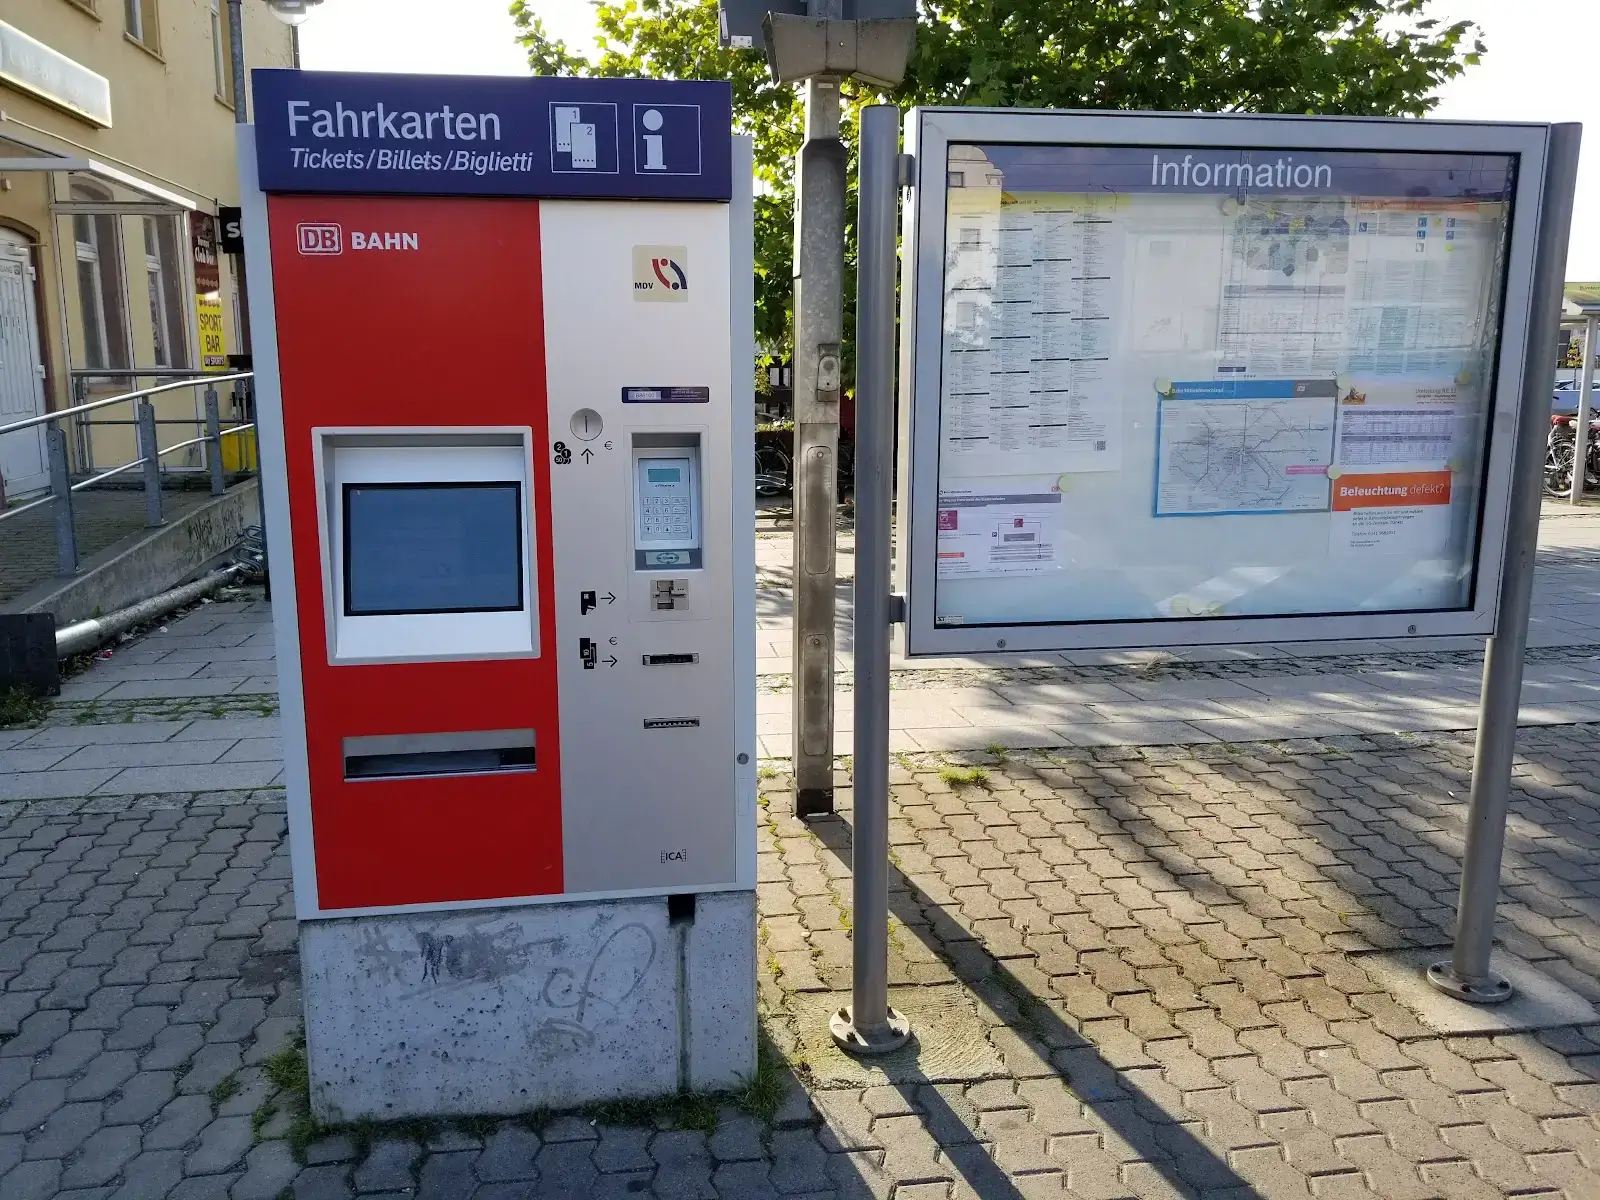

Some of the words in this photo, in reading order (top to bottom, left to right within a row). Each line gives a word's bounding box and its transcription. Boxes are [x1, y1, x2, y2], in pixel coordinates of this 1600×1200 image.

[288, 100, 501, 141] Fahrkarten
[1151, 154, 1332, 188] Information
[302, 228, 336, 249] DB
[351, 231, 419, 250] BAHN
[634, 282, 654, 290] MDV
[200, 313, 222, 332] SPORT
[205, 335, 221, 353] BAR
[1340, 485, 1408, 497] Beleuchtung
[1409, 483, 1445, 495] defekt?
